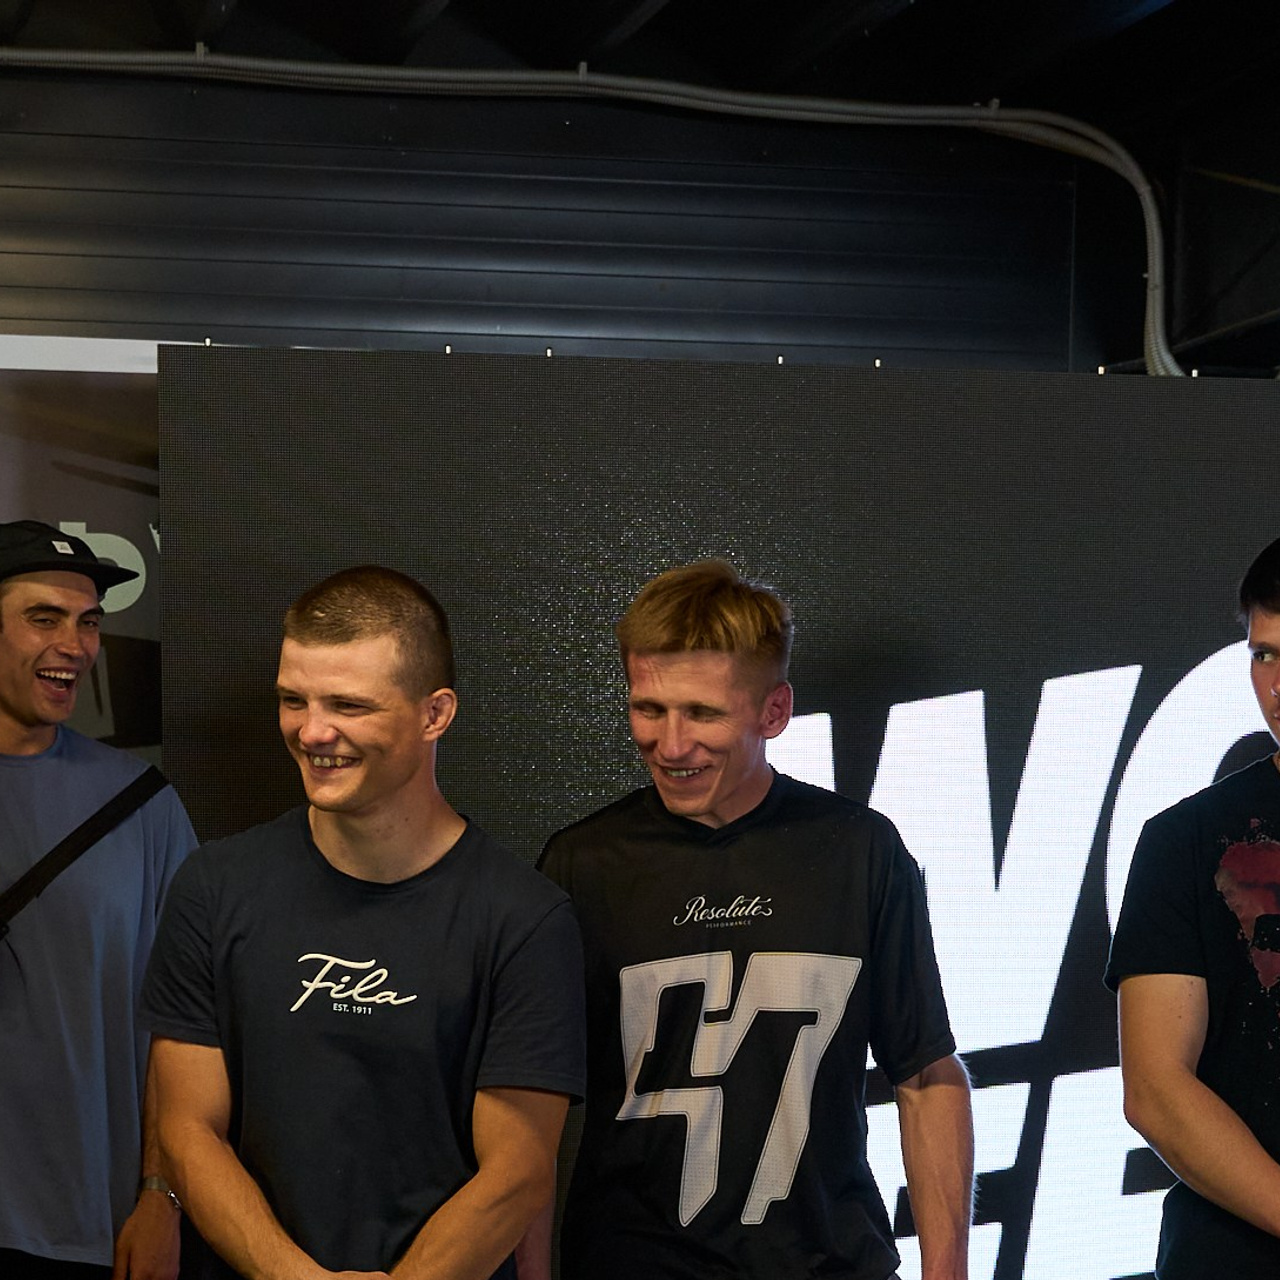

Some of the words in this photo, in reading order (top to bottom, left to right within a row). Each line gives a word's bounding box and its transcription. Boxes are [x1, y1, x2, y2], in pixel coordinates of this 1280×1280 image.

[673, 894, 773, 926] Resolute
[289, 952, 418, 1012] Fila
[332, 1002, 350, 1013] EST.
[352, 1005, 372, 1015] 1911
